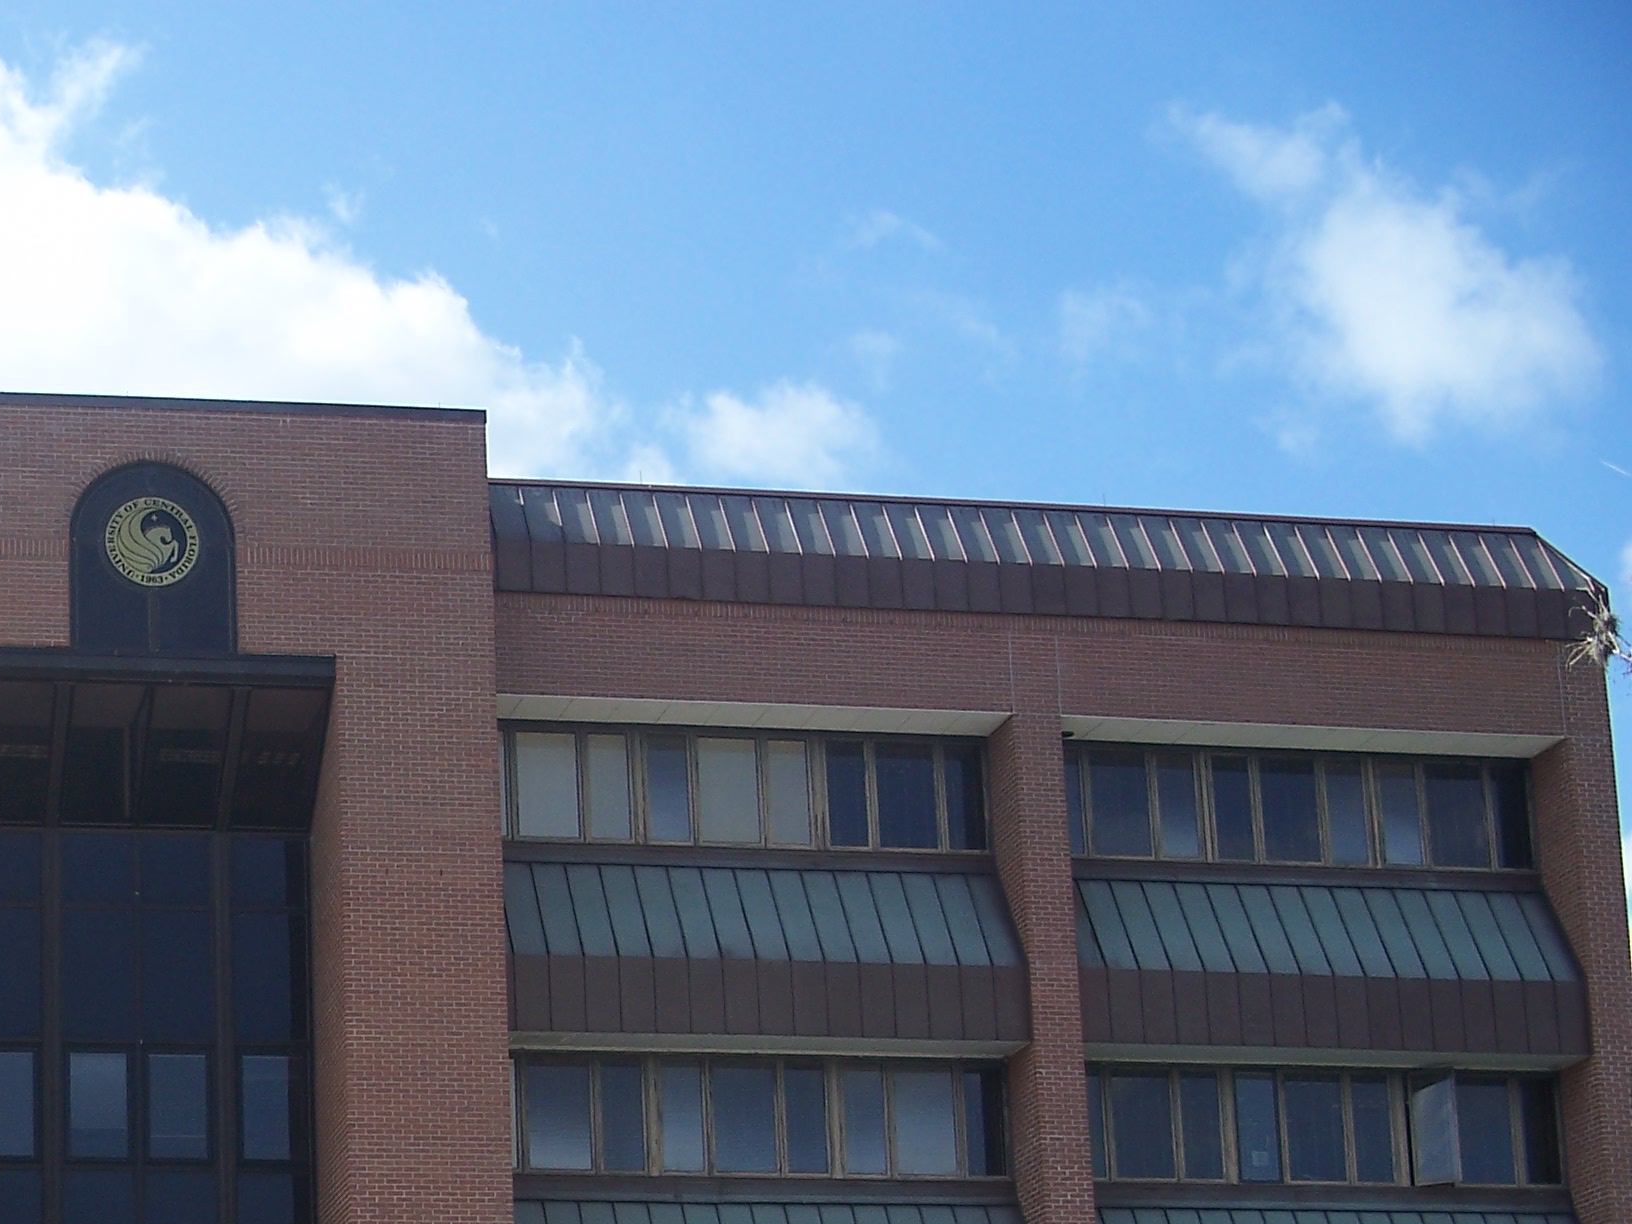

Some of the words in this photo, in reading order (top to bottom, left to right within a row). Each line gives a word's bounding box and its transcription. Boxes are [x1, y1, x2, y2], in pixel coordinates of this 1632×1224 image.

[107, 513, 136, 579] UNIVERSITY
[124, 501, 139, 513] OF
[144, 498, 193, 531] CENTRAL
[169, 535, 197, 580] FLORIDA
[140, 575, 165, 584] 1963
